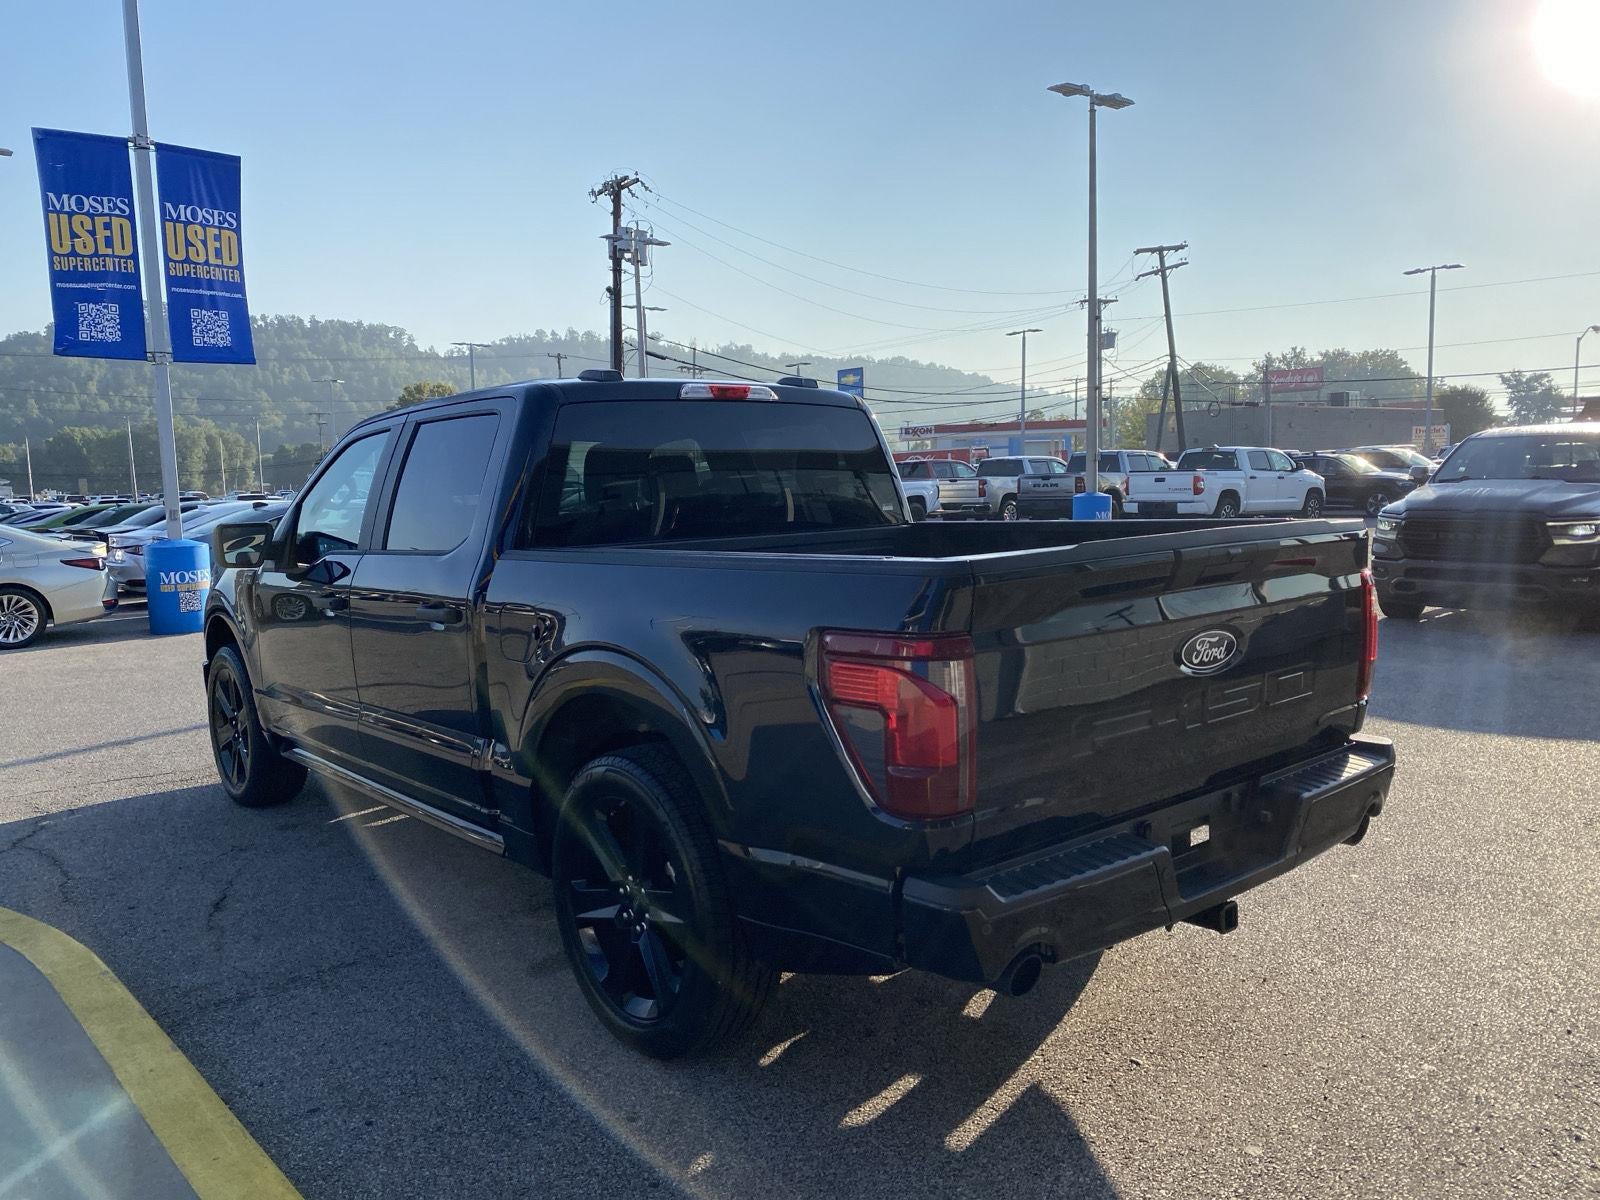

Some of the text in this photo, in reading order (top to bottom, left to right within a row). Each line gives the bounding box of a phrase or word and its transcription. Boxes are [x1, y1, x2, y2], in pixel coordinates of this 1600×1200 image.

[47, 192, 130, 216] MOSES
[163, 202, 237, 229] MOSES
[48, 213, 133, 257] USED
[165, 222, 239, 267] USED
[53, 256, 135, 274] SUPERCENTER
[168, 262, 241, 283] SUPERCENTER
[56, 281, 137, 291] mosesusedsupercenter.com
[904, 426, 933, 438] EXXON
[159, 569, 209, 585] MOSES
[1192, 635, 1227, 664] Ford
